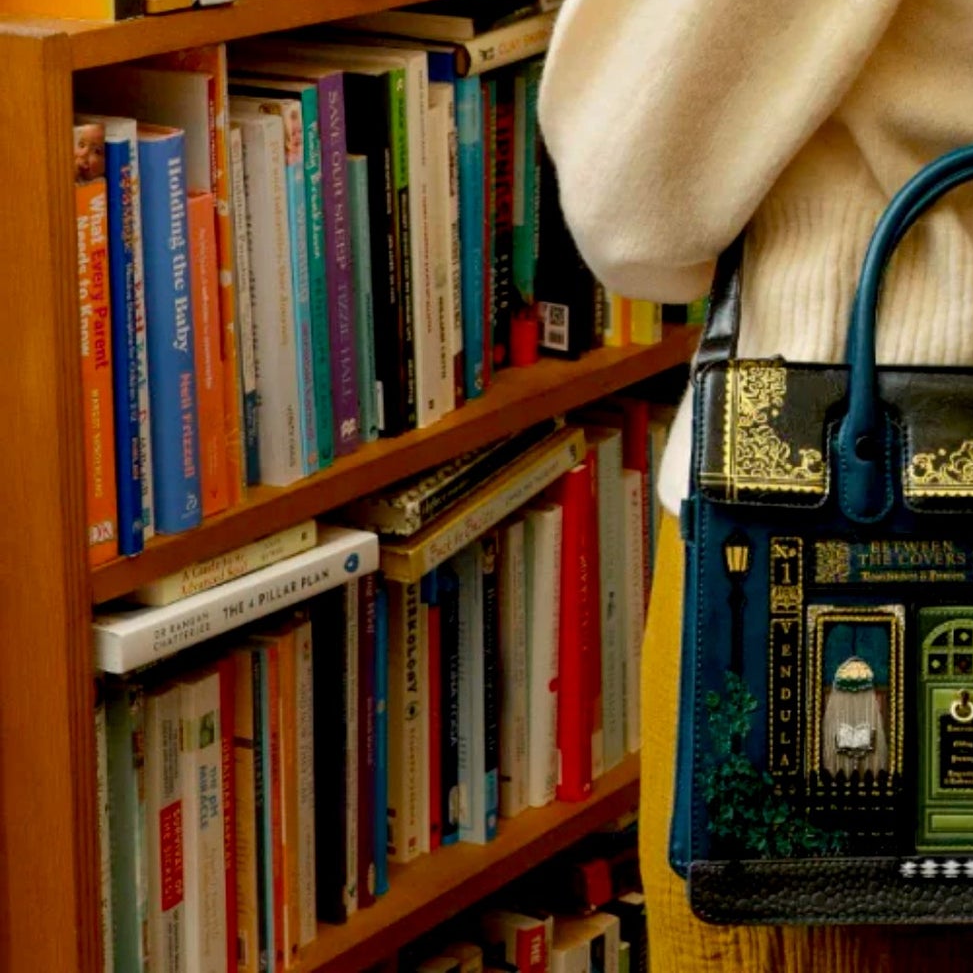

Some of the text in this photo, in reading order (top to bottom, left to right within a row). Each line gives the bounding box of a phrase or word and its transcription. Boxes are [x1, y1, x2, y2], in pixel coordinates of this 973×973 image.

[326, 88, 343, 145] SAVE
[329, 148, 344, 196] OUR
[166, 155, 190, 353] Holding the Baby
[330, 200, 348, 268] SLEEP
[76, 215, 93, 356] Needs to Know
[88, 191, 109, 371] What Every Parent
[180, 372, 195, 479] Nell Frizzell
[780, 563, 792, 585] 1
[858, 552, 895, 567] THE
[222, 567, 331, 621] THE 4 PILLAR PLAN
[778, 620, 794, 768] VENDULA
[162, 816, 173, 839] THE
[173, 878, 184, 896] OF
